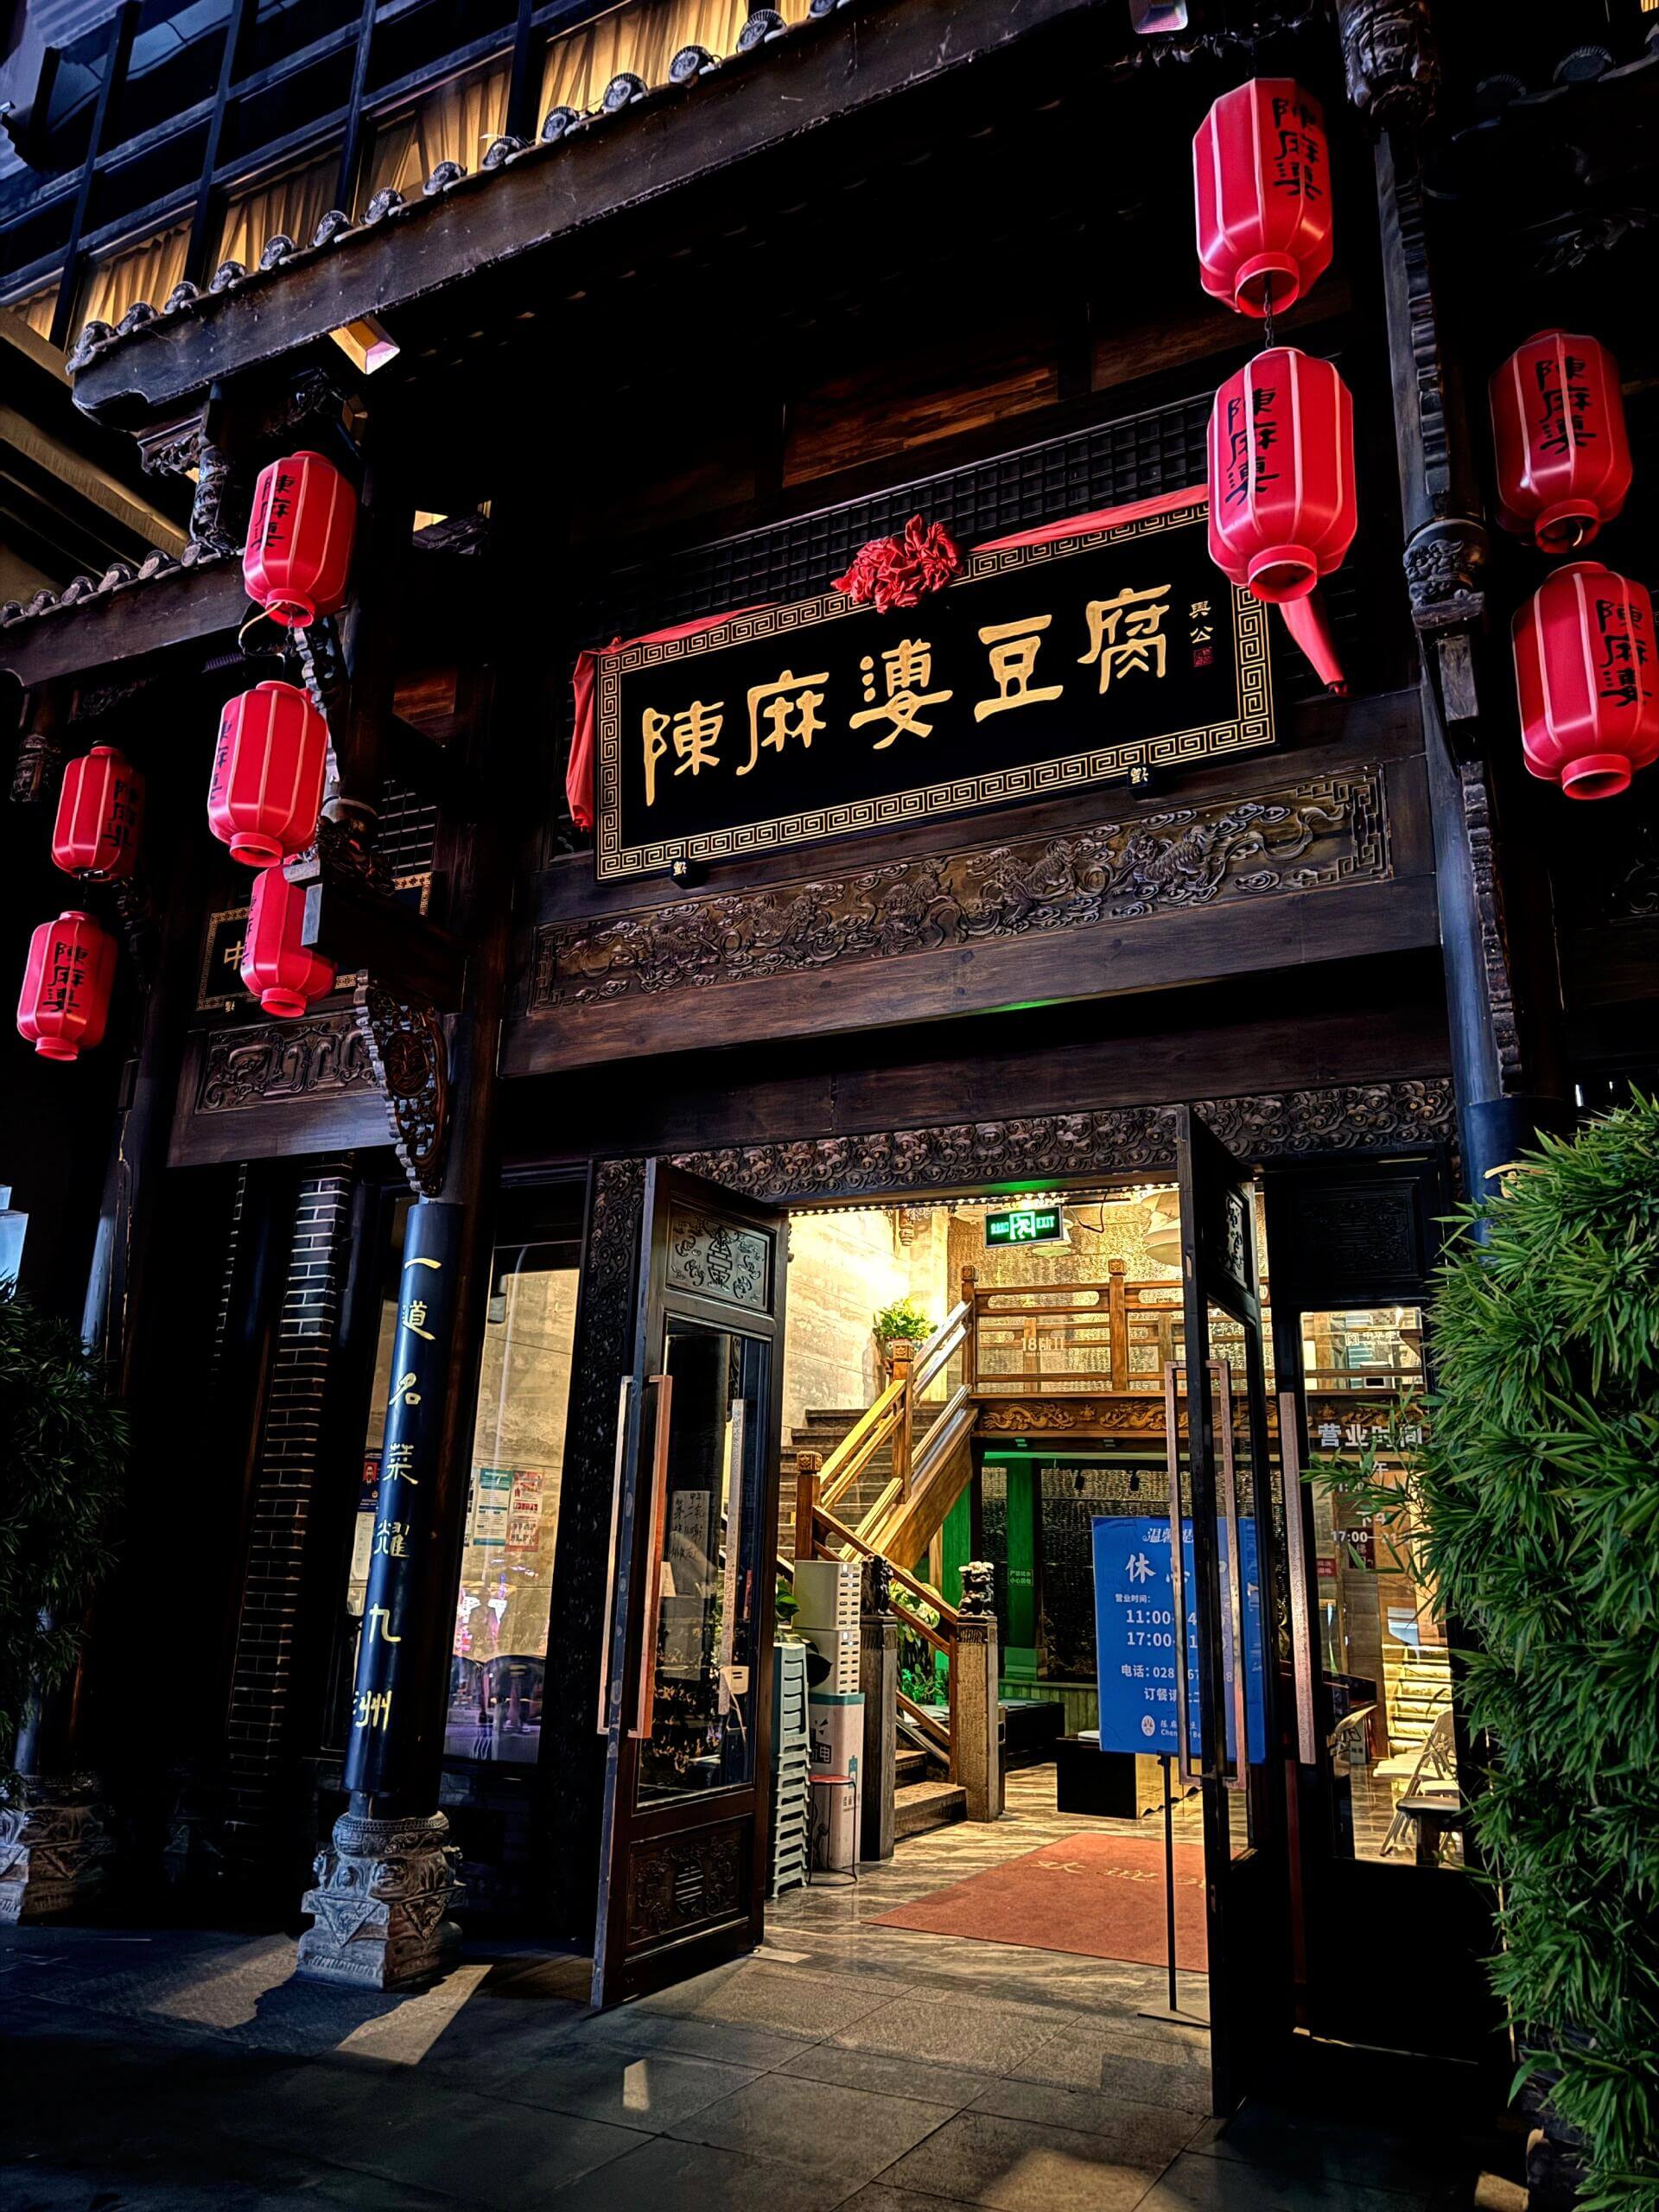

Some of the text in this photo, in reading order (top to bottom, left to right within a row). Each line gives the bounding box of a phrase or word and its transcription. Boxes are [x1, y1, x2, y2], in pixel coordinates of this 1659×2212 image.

[1225, 387, 1281, 505] 陳麻婆
[1535, 355, 1597, 454] 陳麻婆
[643, 583, 1173, 807] 陳麻婆豆腐
[1596, 600, 1652, 707] 陳麻婆
[43, 941, 88, 1014] 陳麻婆
[1036, 1216, 1055, 1229] EXIT
